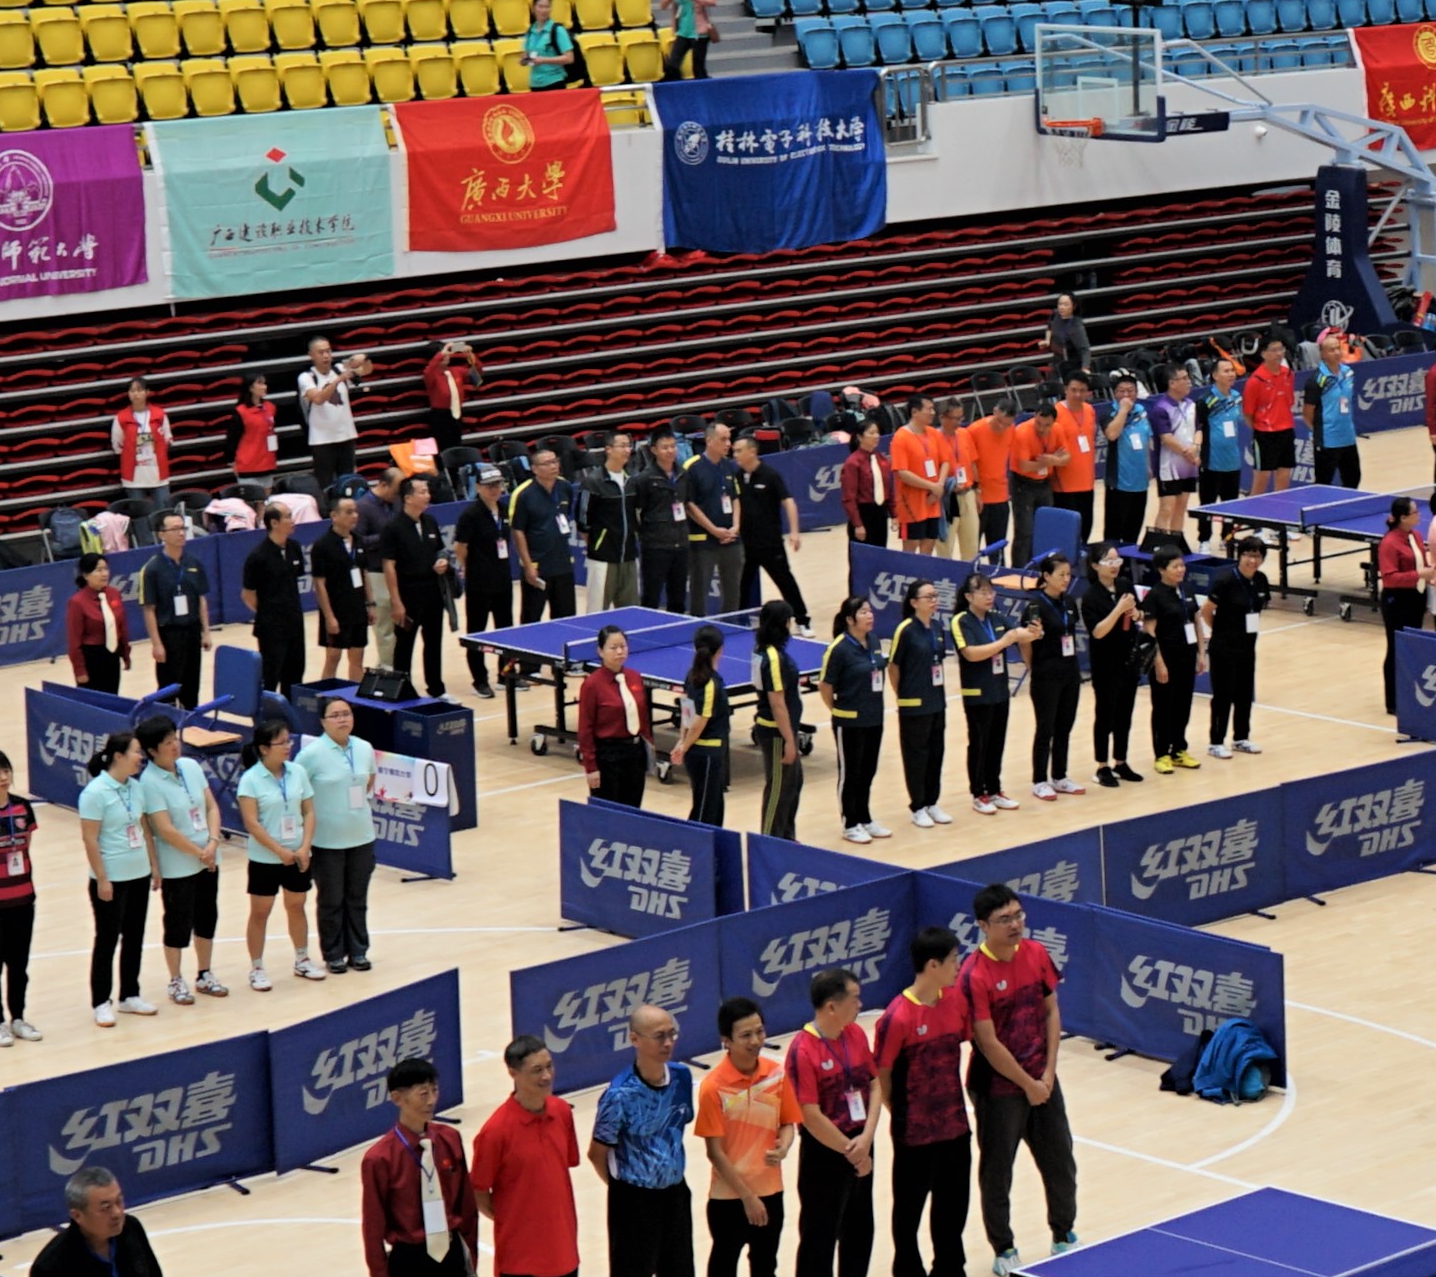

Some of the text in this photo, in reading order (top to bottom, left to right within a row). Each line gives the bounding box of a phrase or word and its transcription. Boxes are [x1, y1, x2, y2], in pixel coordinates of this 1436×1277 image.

[1307, 778, 1424, 856] 红双喜
[1134, 823, 1259, 897] 红双喜
[755, 909, 891, 995] 红双喜
[1121, 952, 1256, 1019] 红双喜
[546, 961, 692, 1051] 红双喜
[50, 1071, 237, 1173] 红双喜
